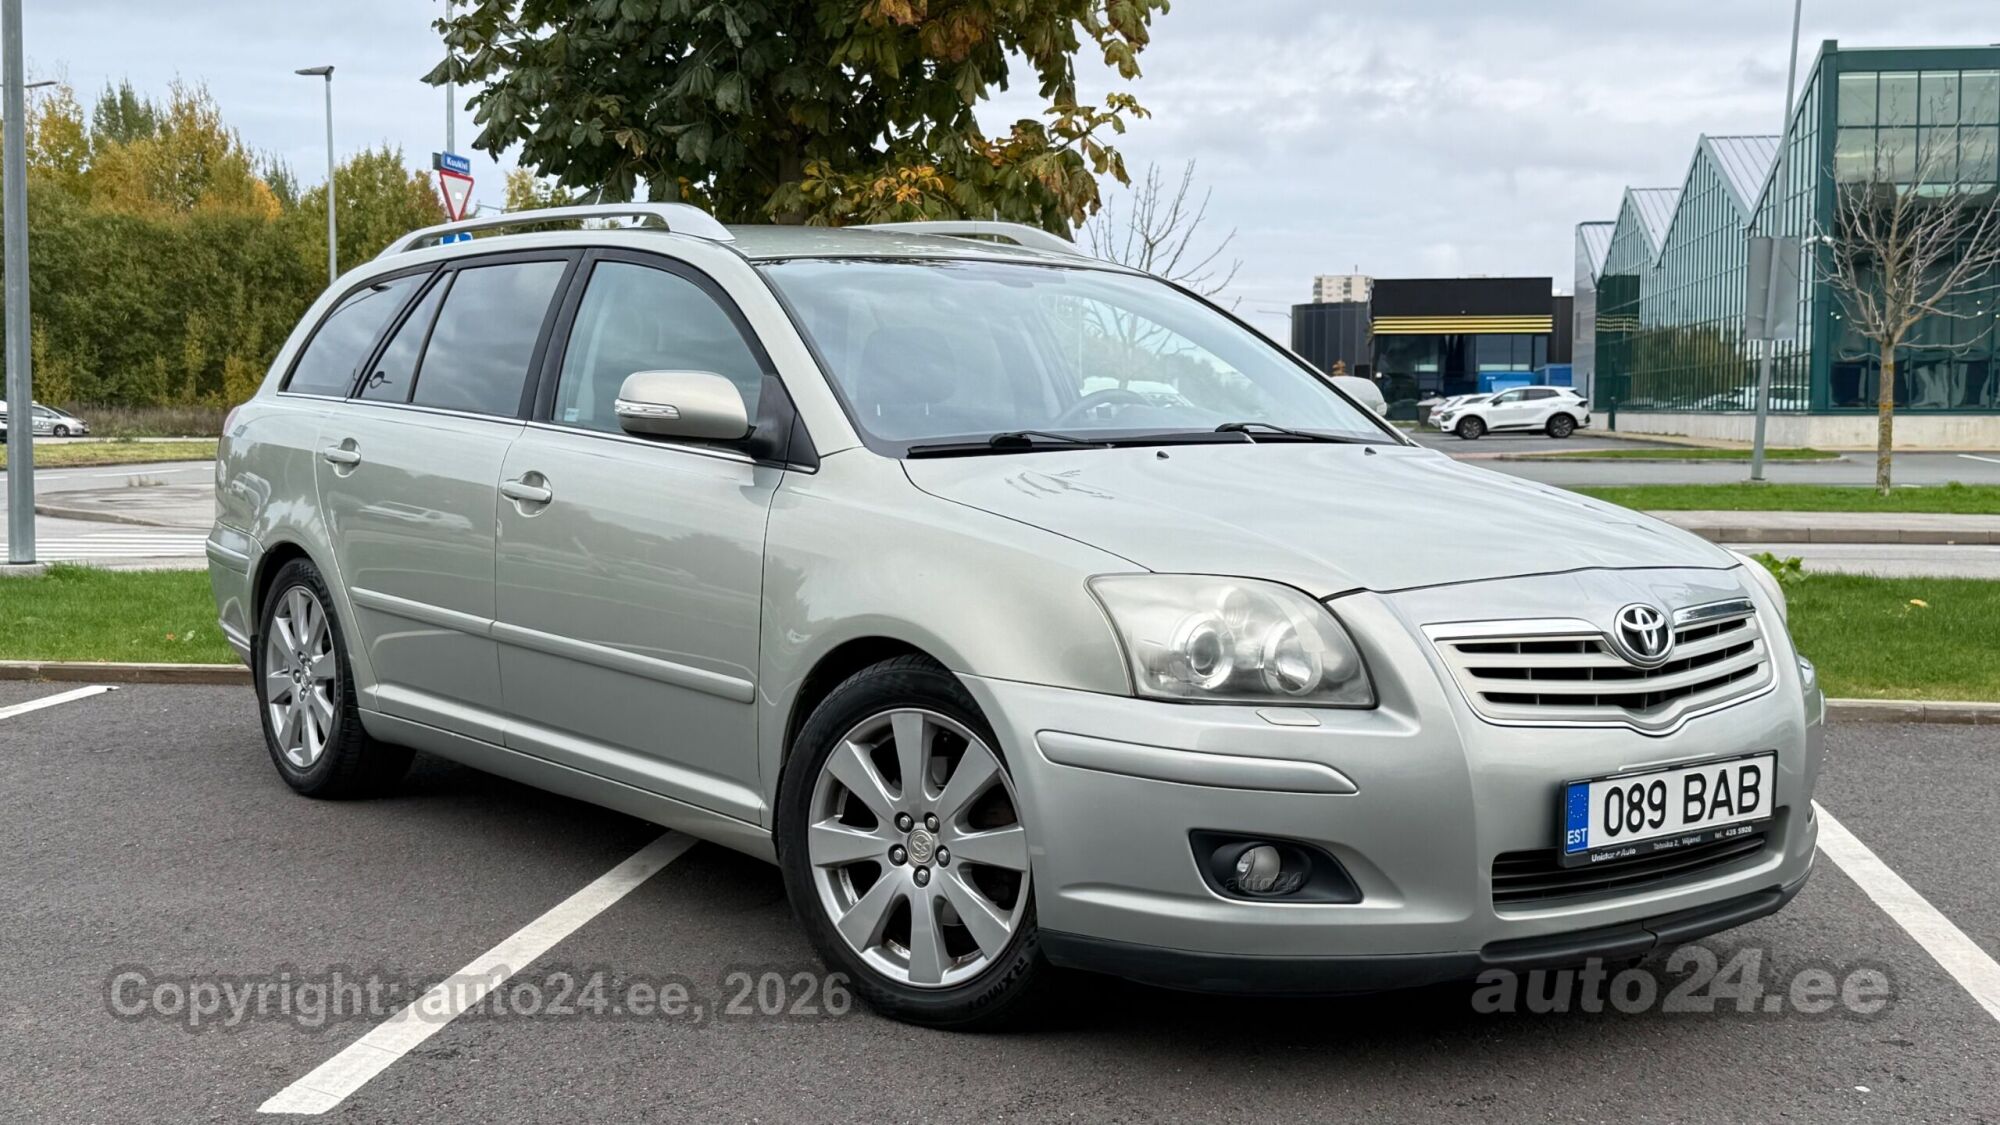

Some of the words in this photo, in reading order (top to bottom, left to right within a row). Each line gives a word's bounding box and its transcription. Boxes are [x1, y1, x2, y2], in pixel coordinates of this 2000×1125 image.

[1604, 779, 1667, 837] 089
[1683, 764, 1761, 824] BAB
[1567, 827, 1587, 845] EST
